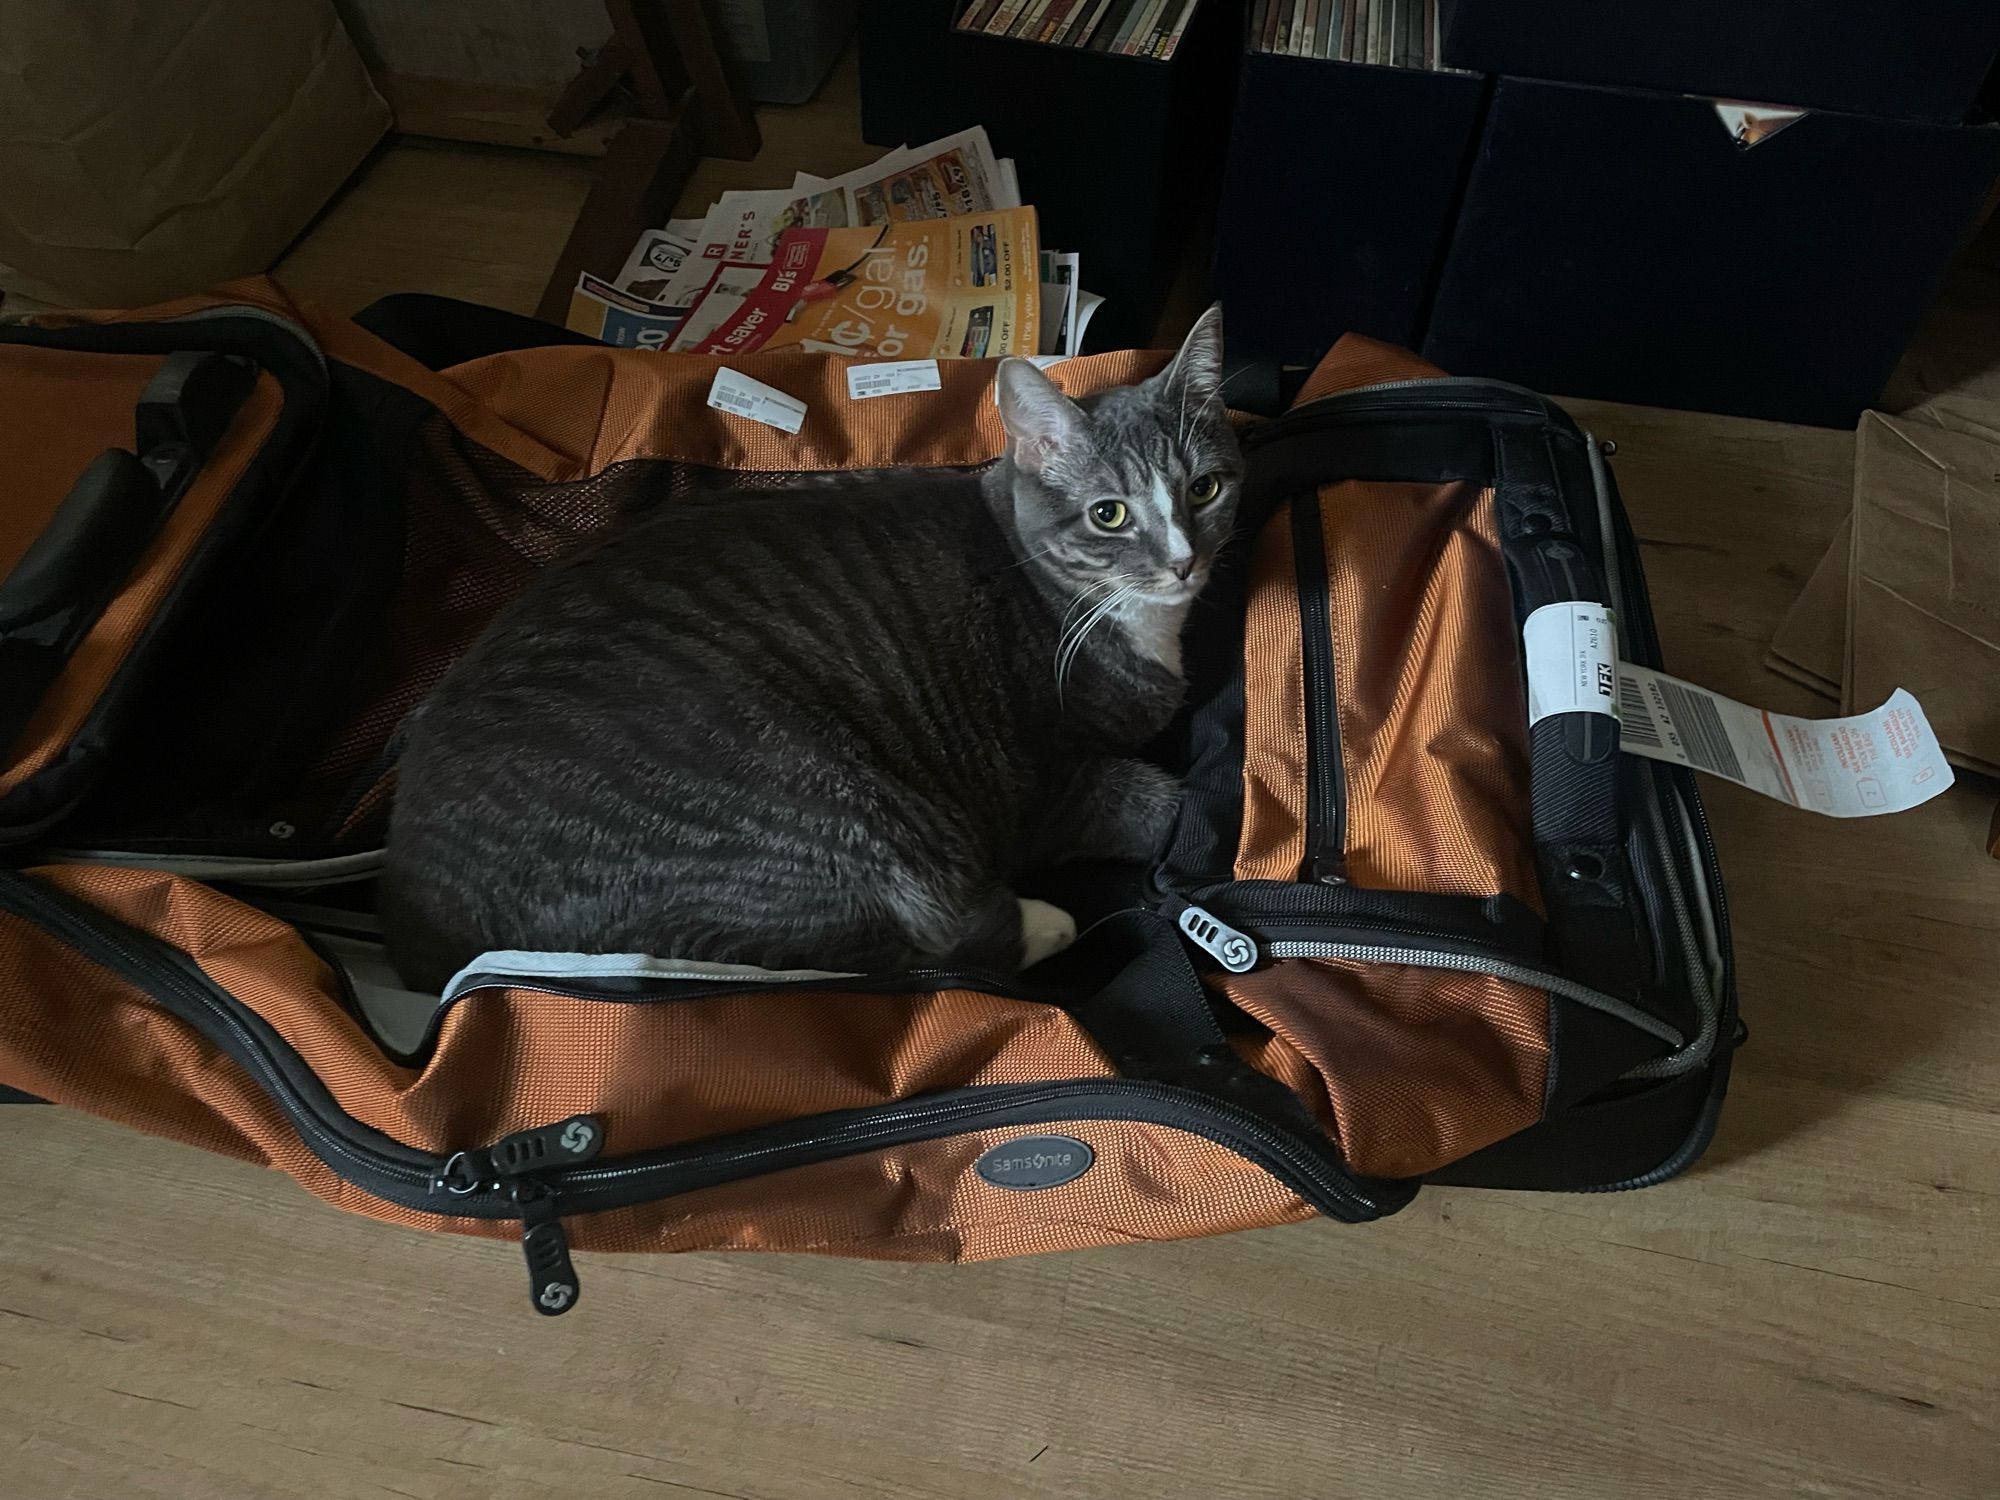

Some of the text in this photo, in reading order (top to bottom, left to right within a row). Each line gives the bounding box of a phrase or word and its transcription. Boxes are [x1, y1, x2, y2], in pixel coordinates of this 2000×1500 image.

[1002, 242, 1010, 261] OFF
[772, 269, 797, 292] BJ's
[898, 236, 928, 314] gas.
[724, 309, 768, 345] saver
[1002, 321, 1010, 340] OFF
[1580, 675, 1588, 687] NEW
[1599, 663, 1612, 696] JFK
[993, 1153, 1071, 1172] Samsonite
